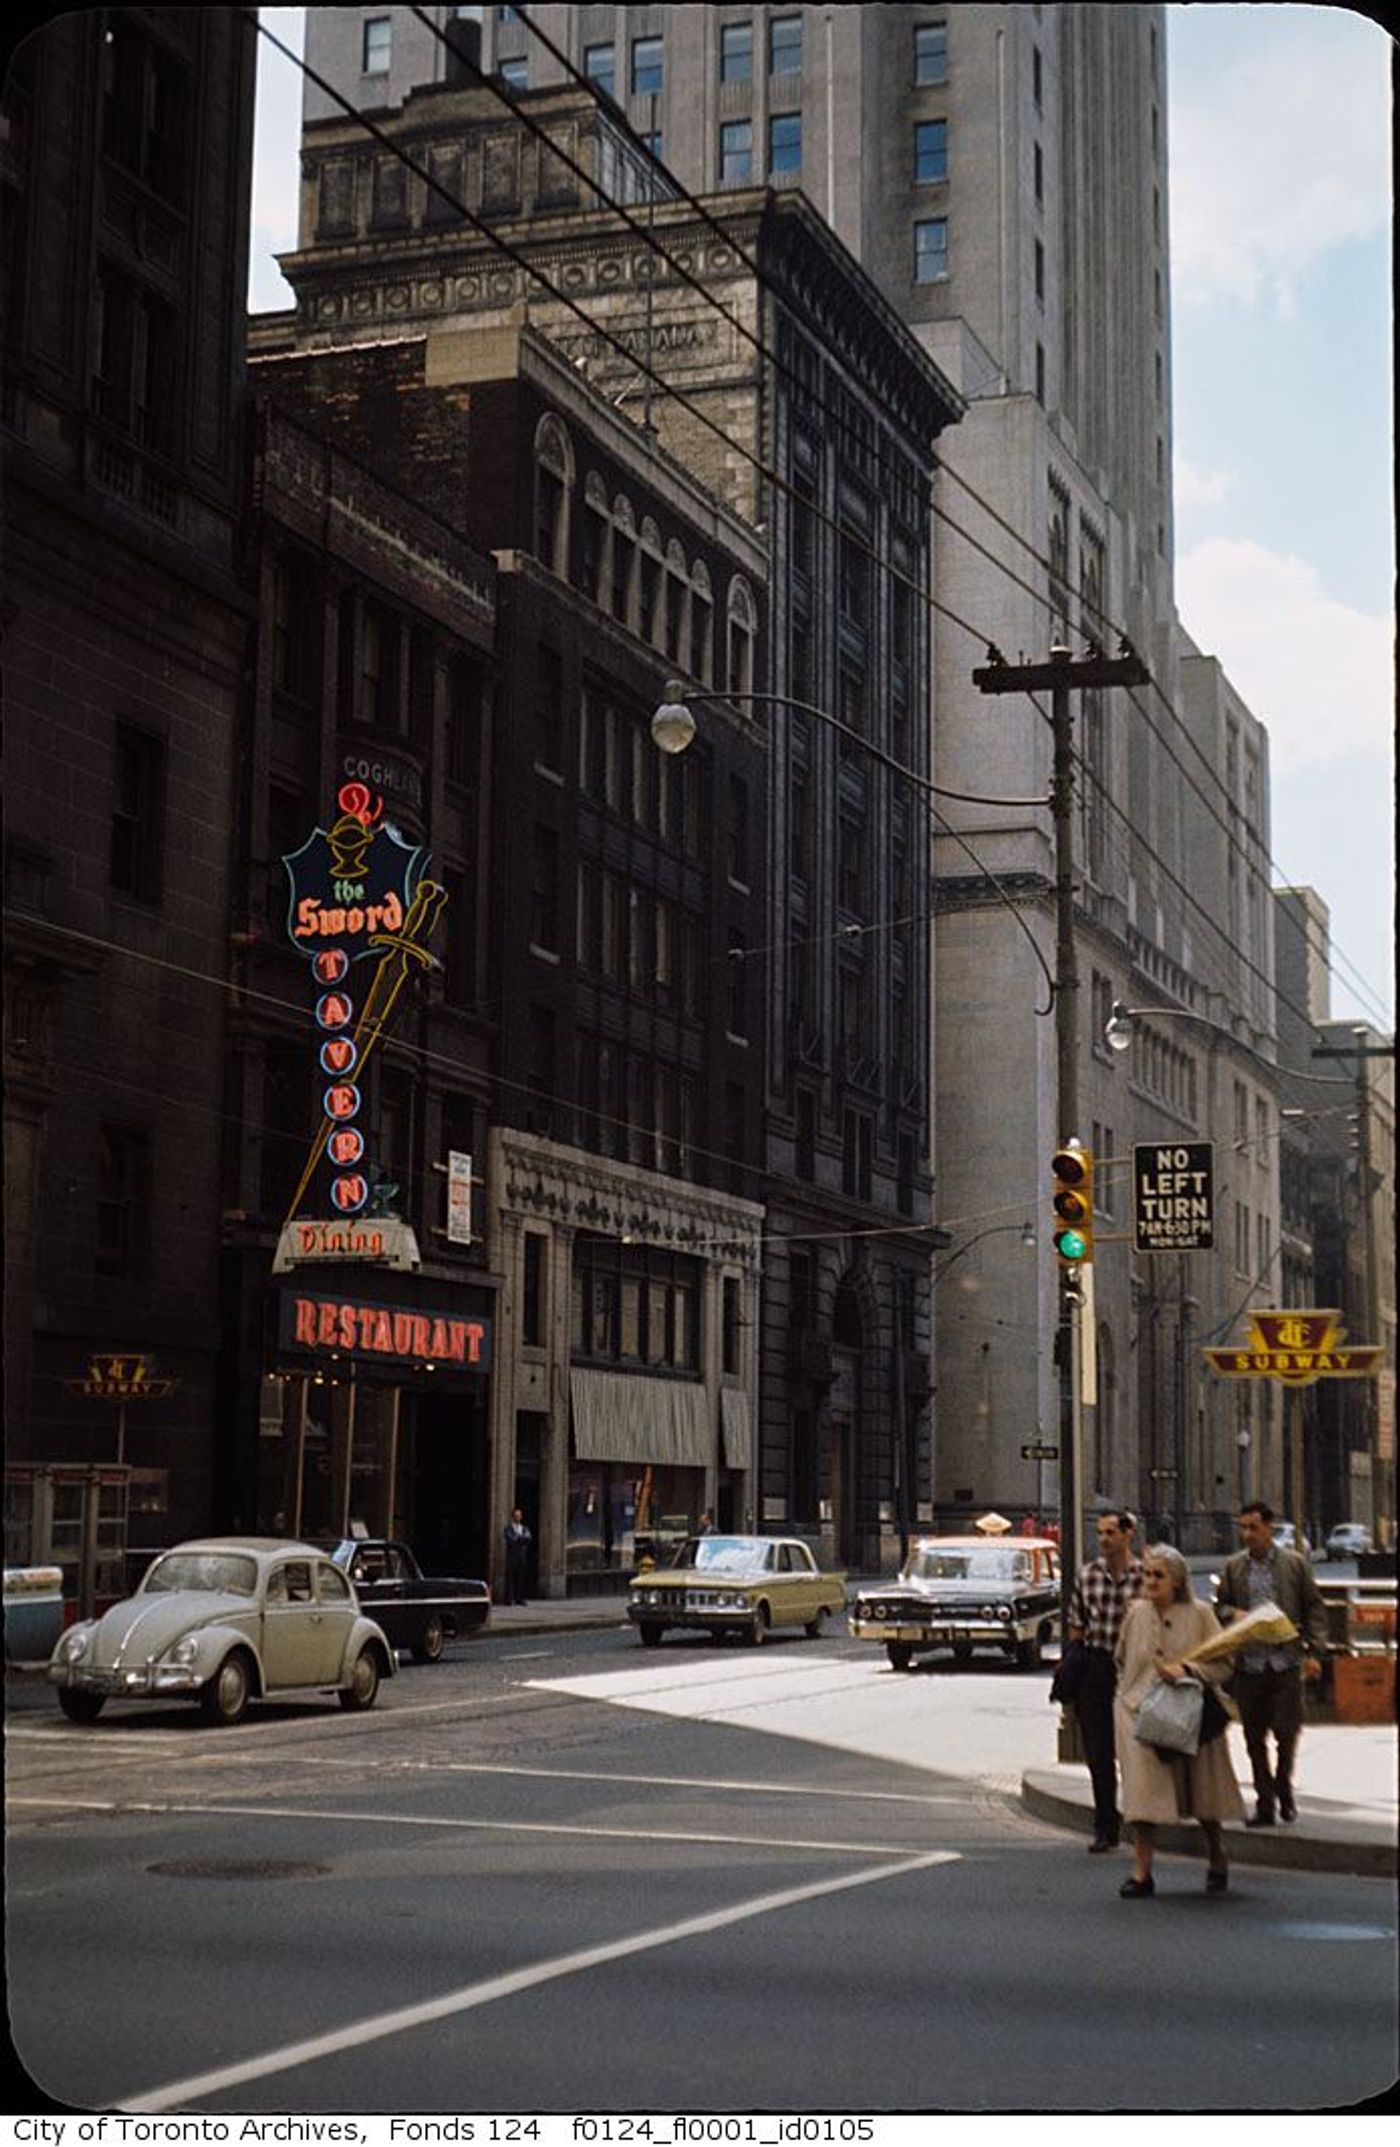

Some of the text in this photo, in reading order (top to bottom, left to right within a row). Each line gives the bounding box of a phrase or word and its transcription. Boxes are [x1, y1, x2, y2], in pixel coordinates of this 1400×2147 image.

[333, 881, 365, 902] the
[296, 893, 402, 936] Sword
[318, 949, 364, 1211] TAVERN
[1156, 1148, 1190, 1170] NO
[1141, 1171, 1208, 1196] LEFT
[1141, 1197, 1208, 1221] TURN
[297, 1219, 385, 1256] Dining
[296, 1299, 483, 1362] RESTAURANT
[1235, 1353, 1351, 1370] SUBWAY
[84, 1383, 152, 1395] SUBWAY
